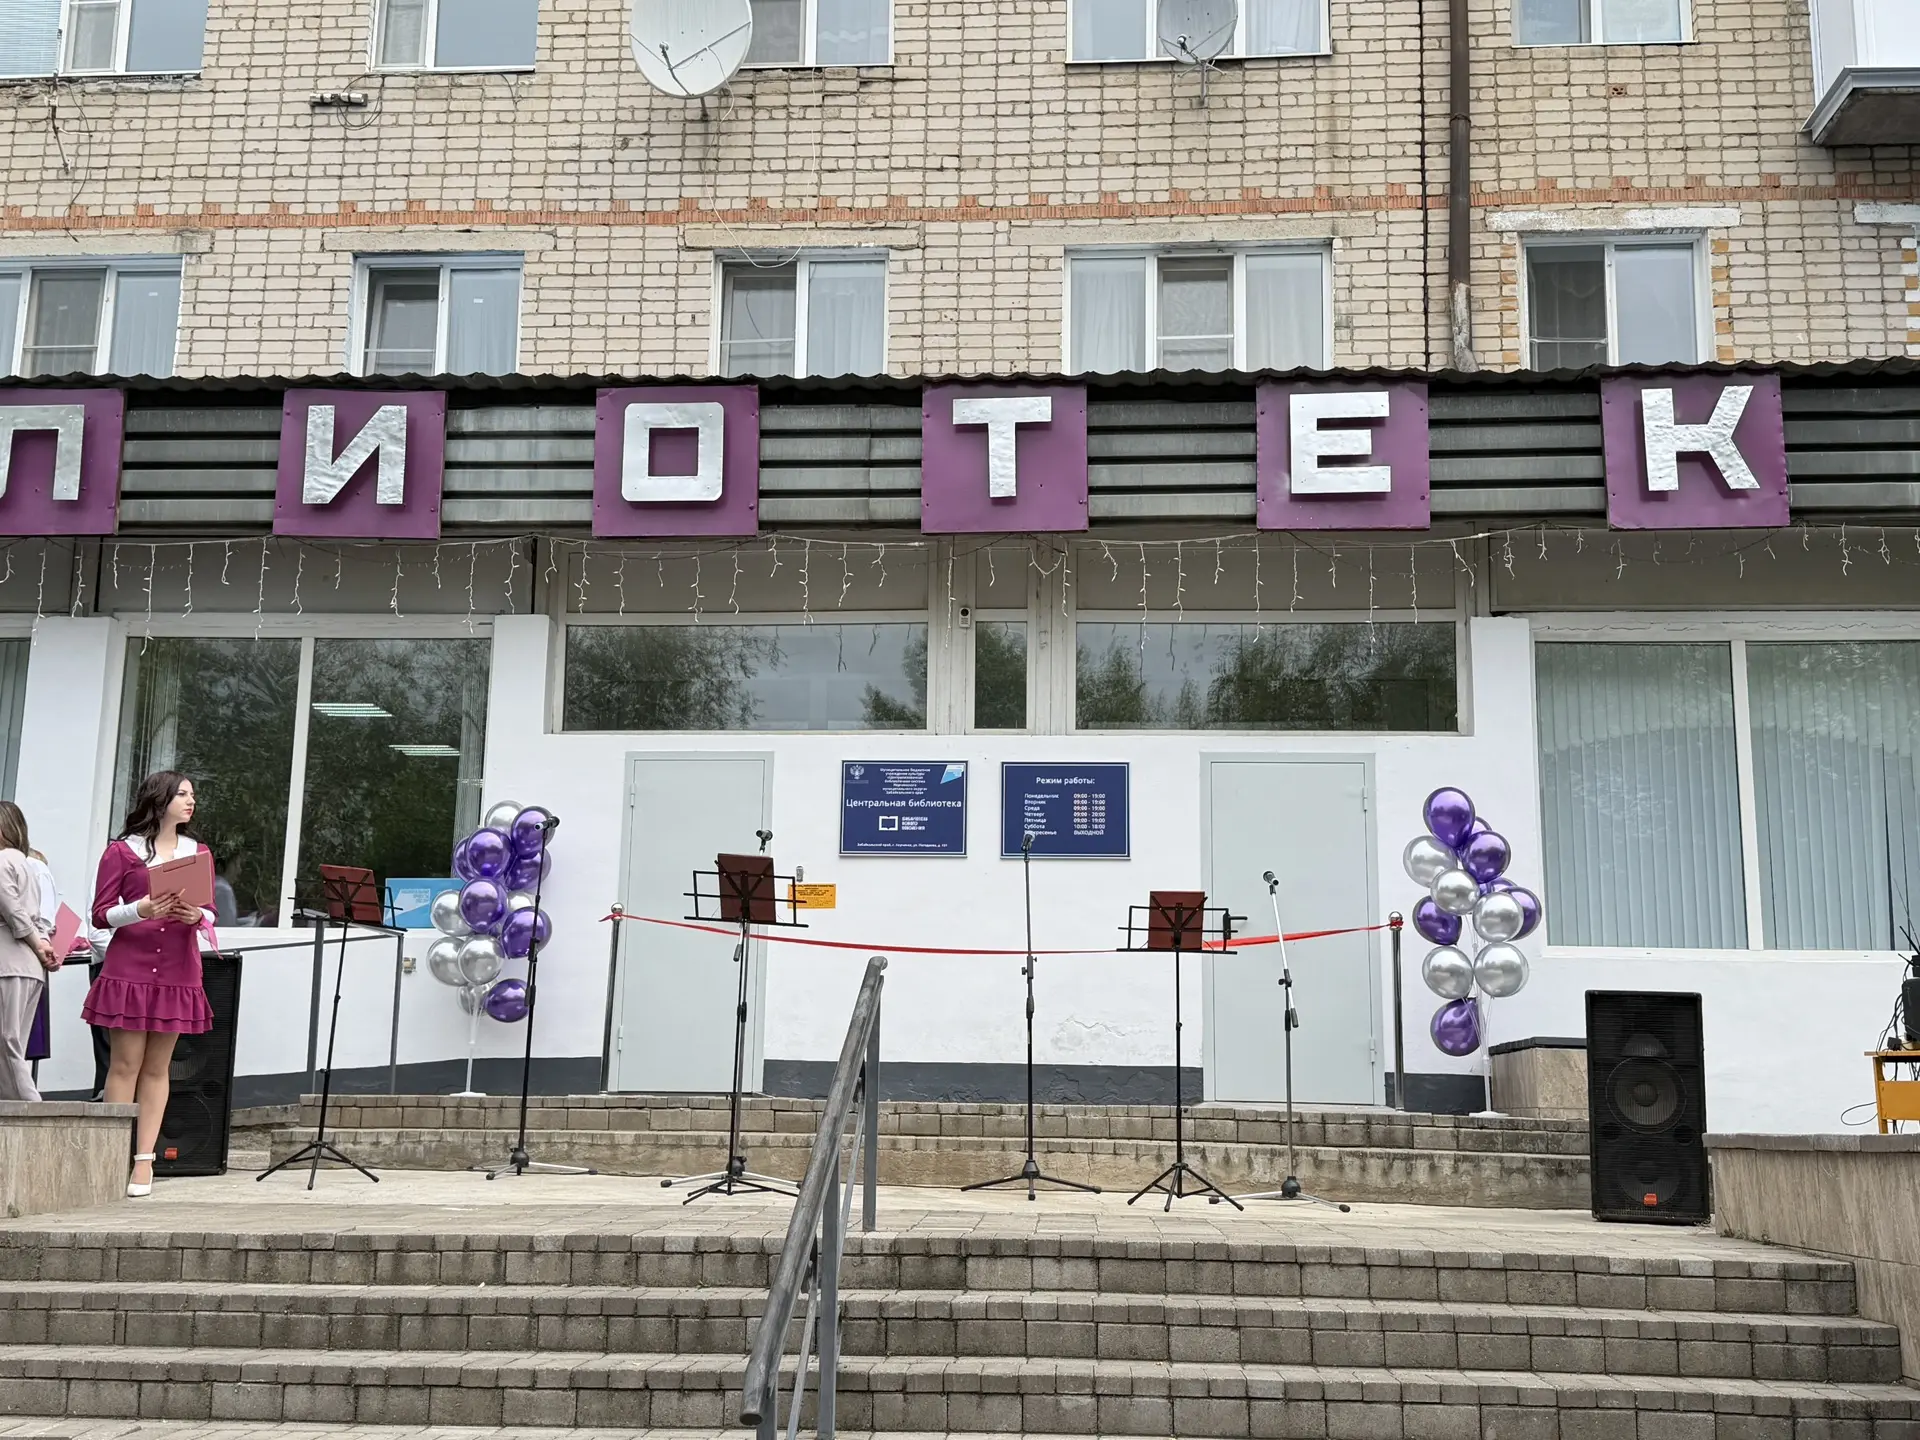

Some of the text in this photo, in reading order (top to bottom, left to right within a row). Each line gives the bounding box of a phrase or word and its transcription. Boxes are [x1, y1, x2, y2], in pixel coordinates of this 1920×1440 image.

[1064, 777, 1095, 785] работы:
[846, 798, 962, 808] Центральная библиотека
